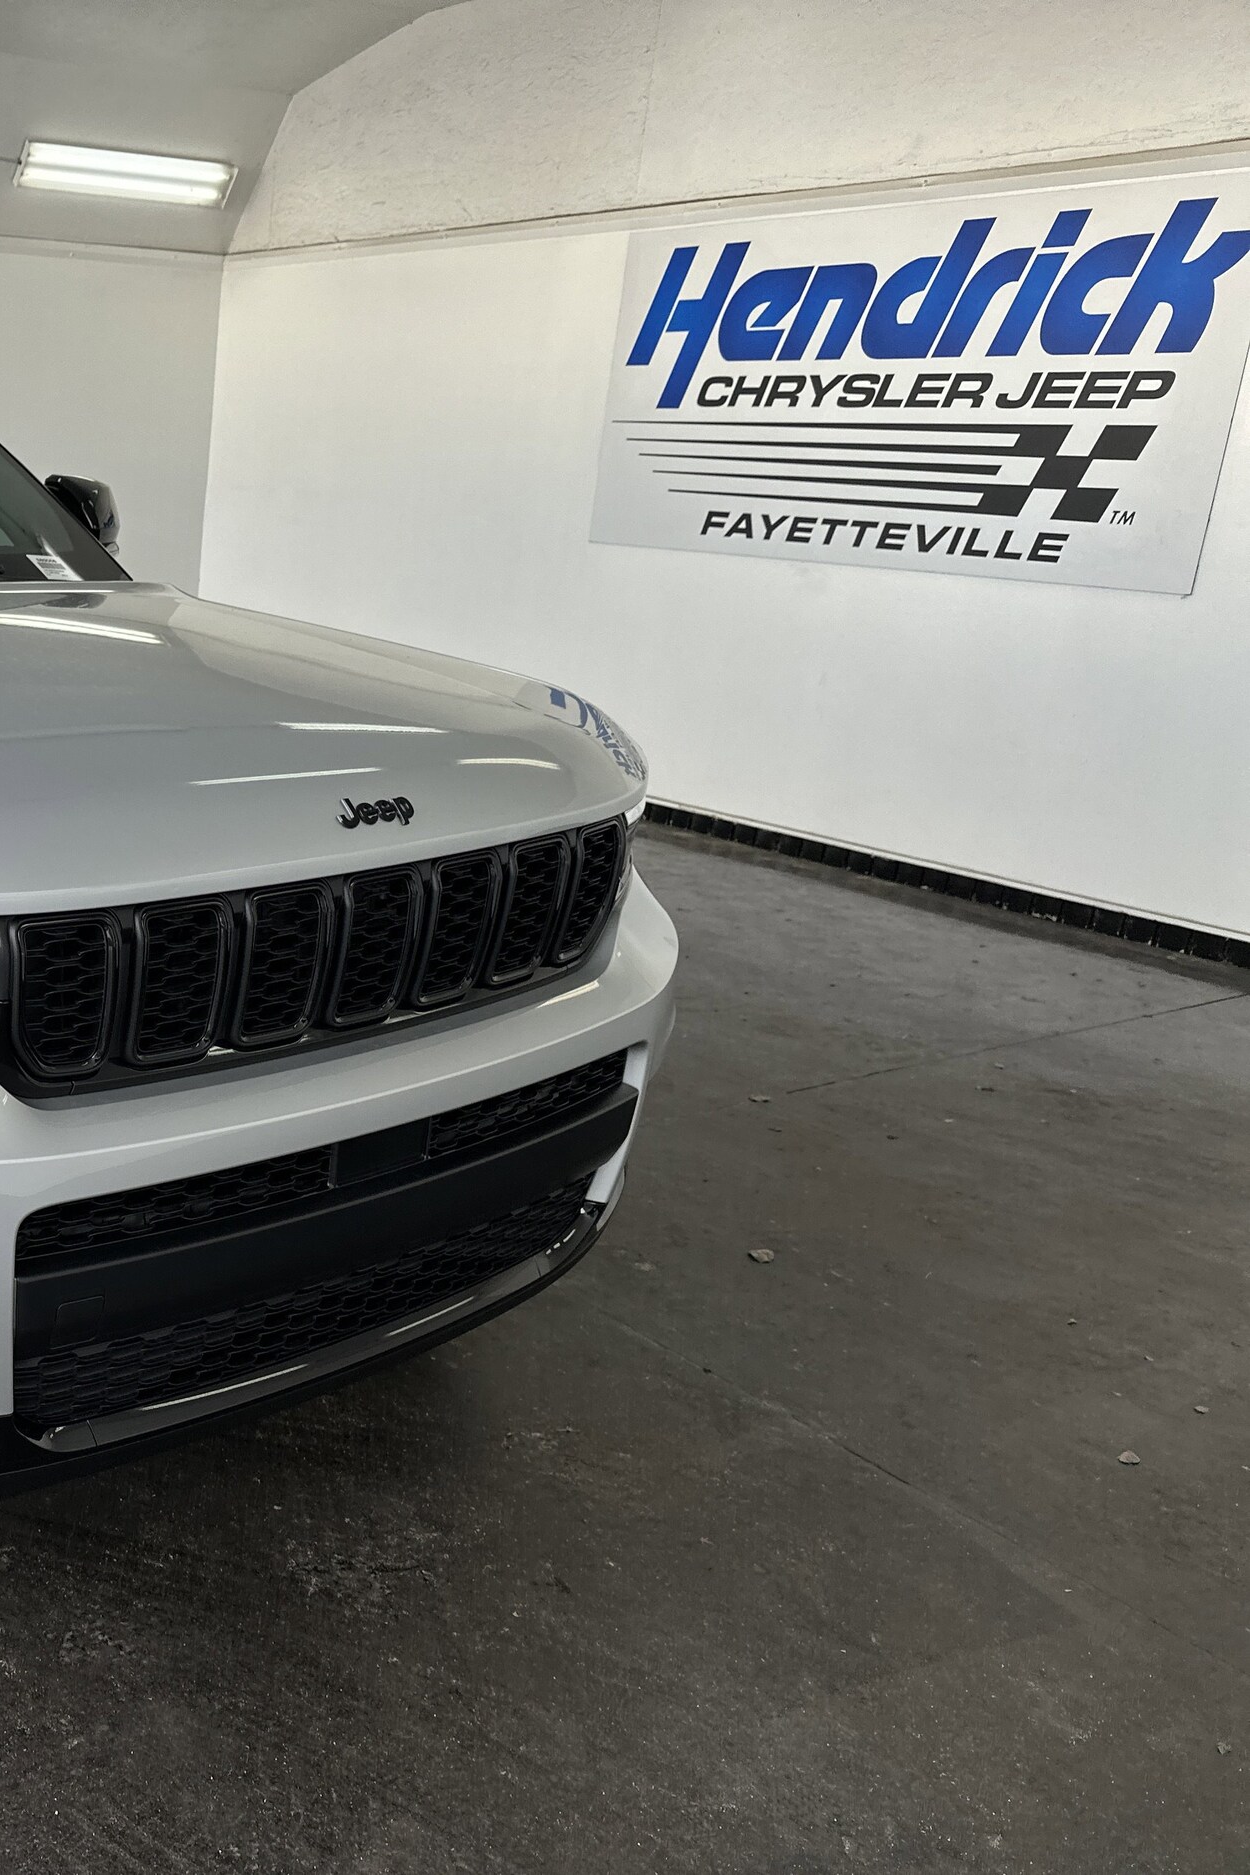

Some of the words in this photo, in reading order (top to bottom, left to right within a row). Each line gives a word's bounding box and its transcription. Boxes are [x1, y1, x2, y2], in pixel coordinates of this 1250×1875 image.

[626, 197, 1250, 409] Hendrick
[696, 372, 994, 409] CHRYSLER
[996, 370, 1177, 409] JEEP
[700, 510, 1070, 563] FAYETTEVILLE
[1109, 510, 1136, 526] TM
[336, 796, 415, 829] Jeep
